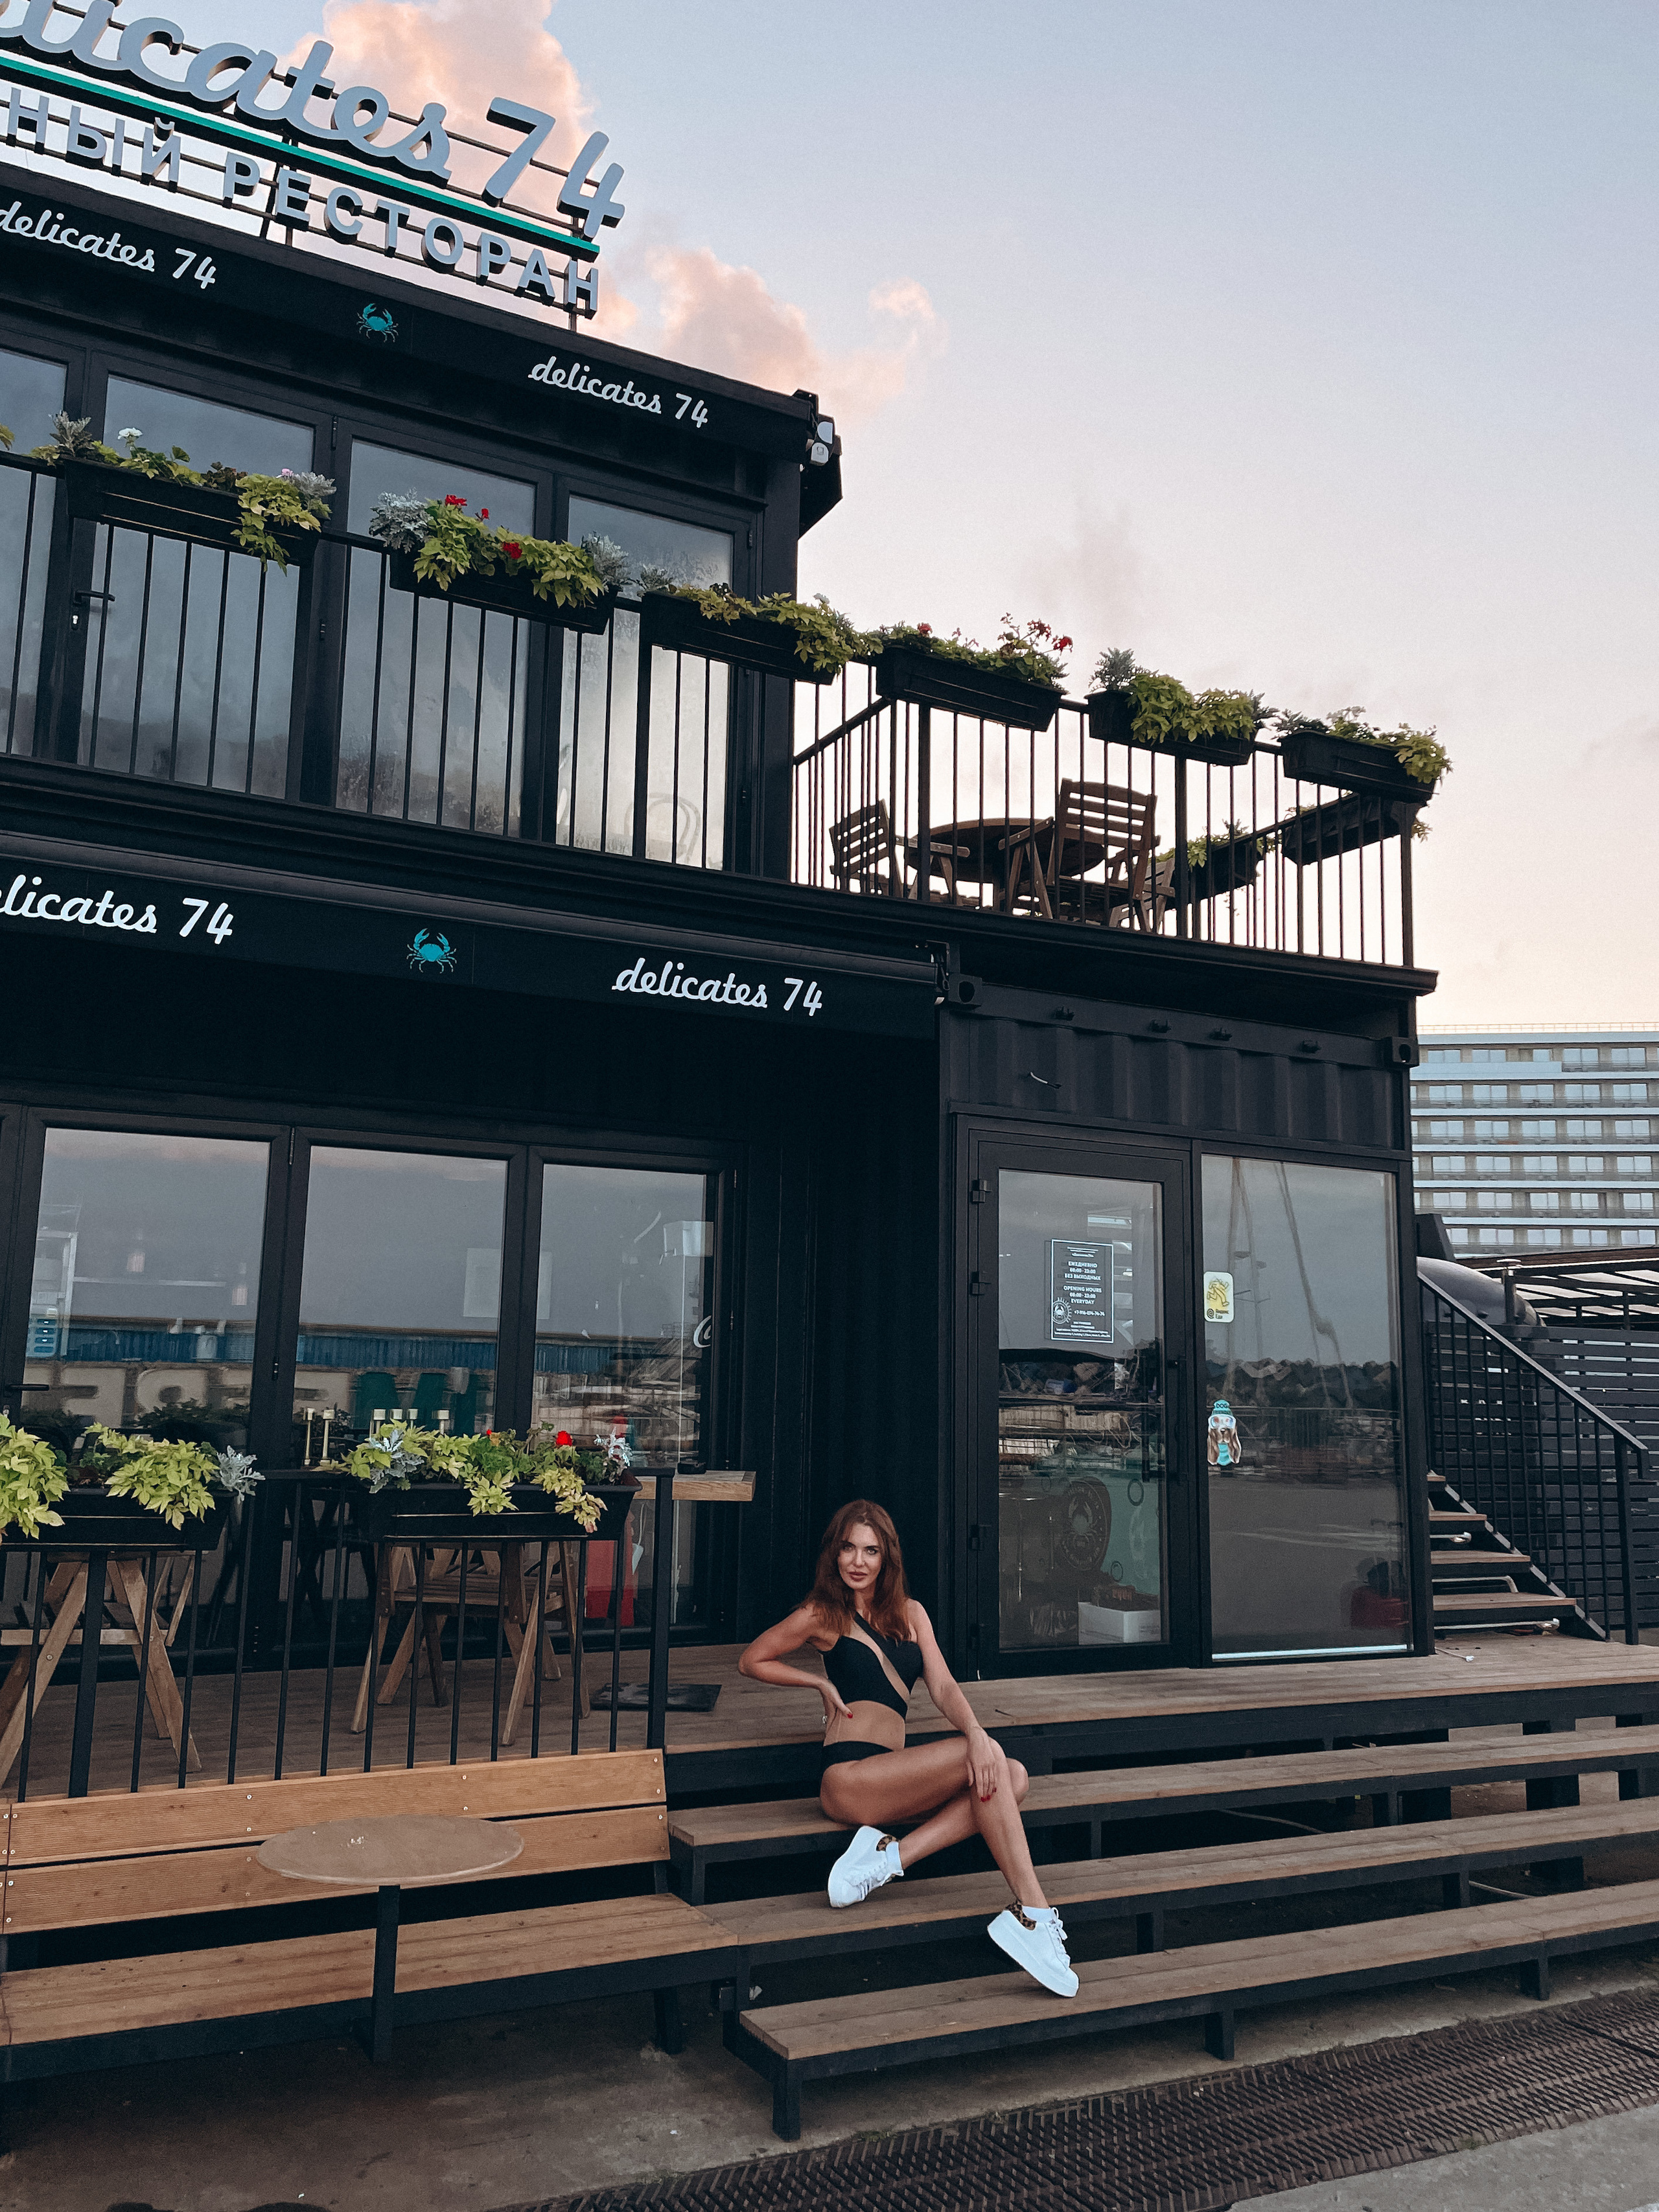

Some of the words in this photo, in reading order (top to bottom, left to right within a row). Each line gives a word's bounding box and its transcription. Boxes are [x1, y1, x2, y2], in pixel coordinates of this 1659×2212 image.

[7, 87, 181, 192] НЫЙ
[223, 151, 599, 318] РЕСТОРАН
[485, 97, 625, 238] 74
[0, 201, 155, 272] delicates
[172, 248, 217, 290] 74
[528, 356, 662, 415] delicates
[675, 392, 708, 428] 74
[0, 874, 157, 934] licates
[179, 897, 234, 945] 74
[611, 957, 768, 1009] delicates
[783, 977, 823, 1017] 74
